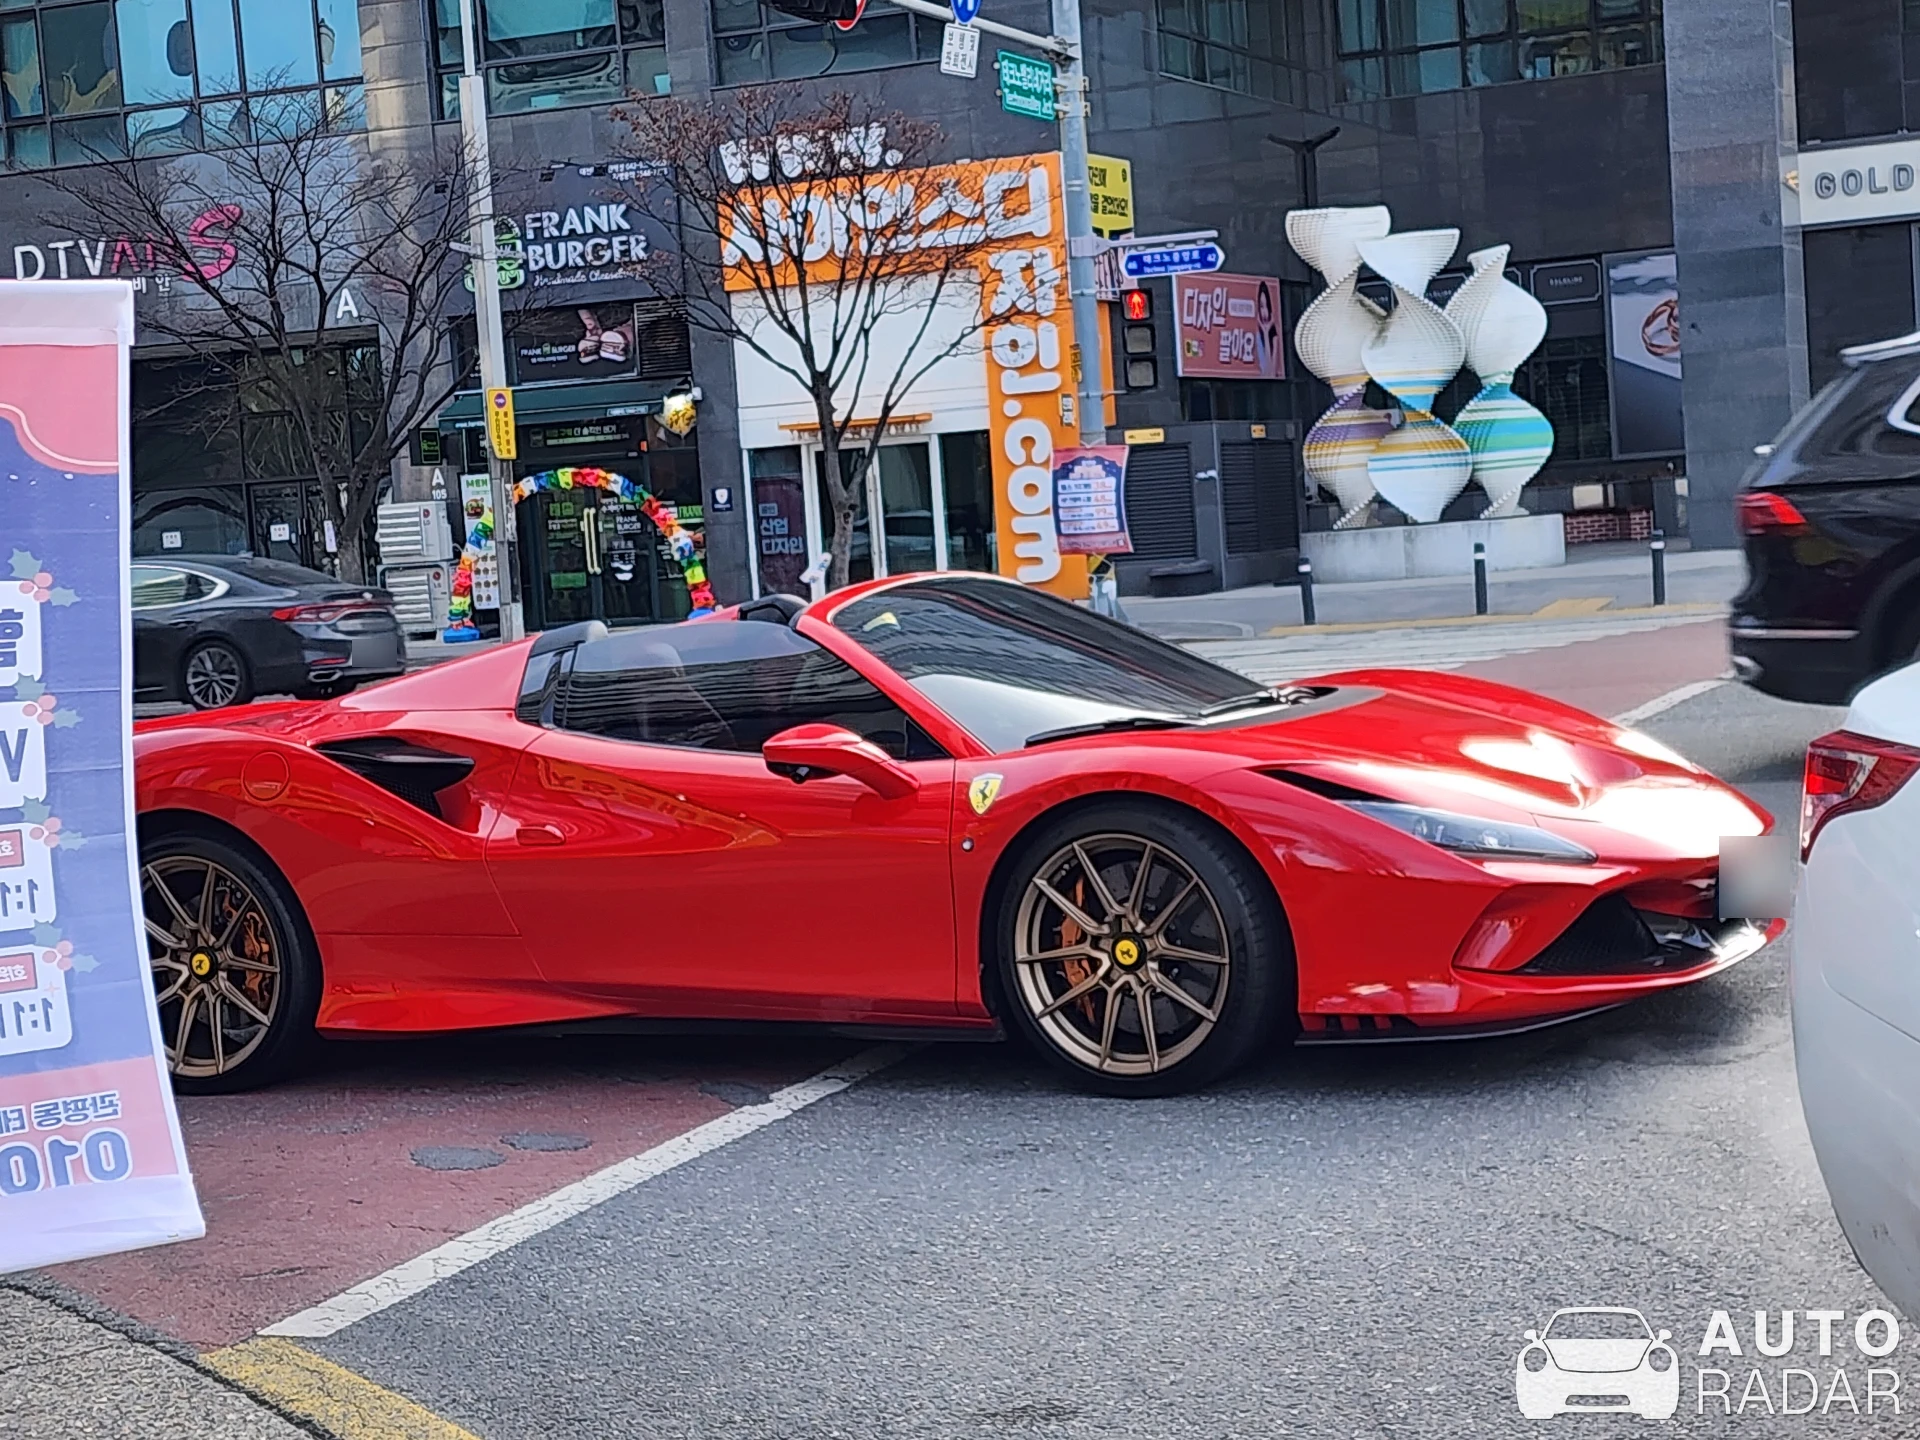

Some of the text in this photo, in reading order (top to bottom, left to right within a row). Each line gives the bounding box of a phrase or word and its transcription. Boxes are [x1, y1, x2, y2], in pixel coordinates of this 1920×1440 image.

[1814, 163, 1914, 199] GOLD
[524, 204, 630, 240] FRANK
[527, 234, 648, 271] BURGER
[1183, 287, 1228, 333] 디자인
[432, 468, 445, 486] A
[466, 478, 488, 489] MEN
[431, 488, 447, 500] 105
[760, 516, 788, 536] 산업
[762, 535, 804, 555] 디자인
